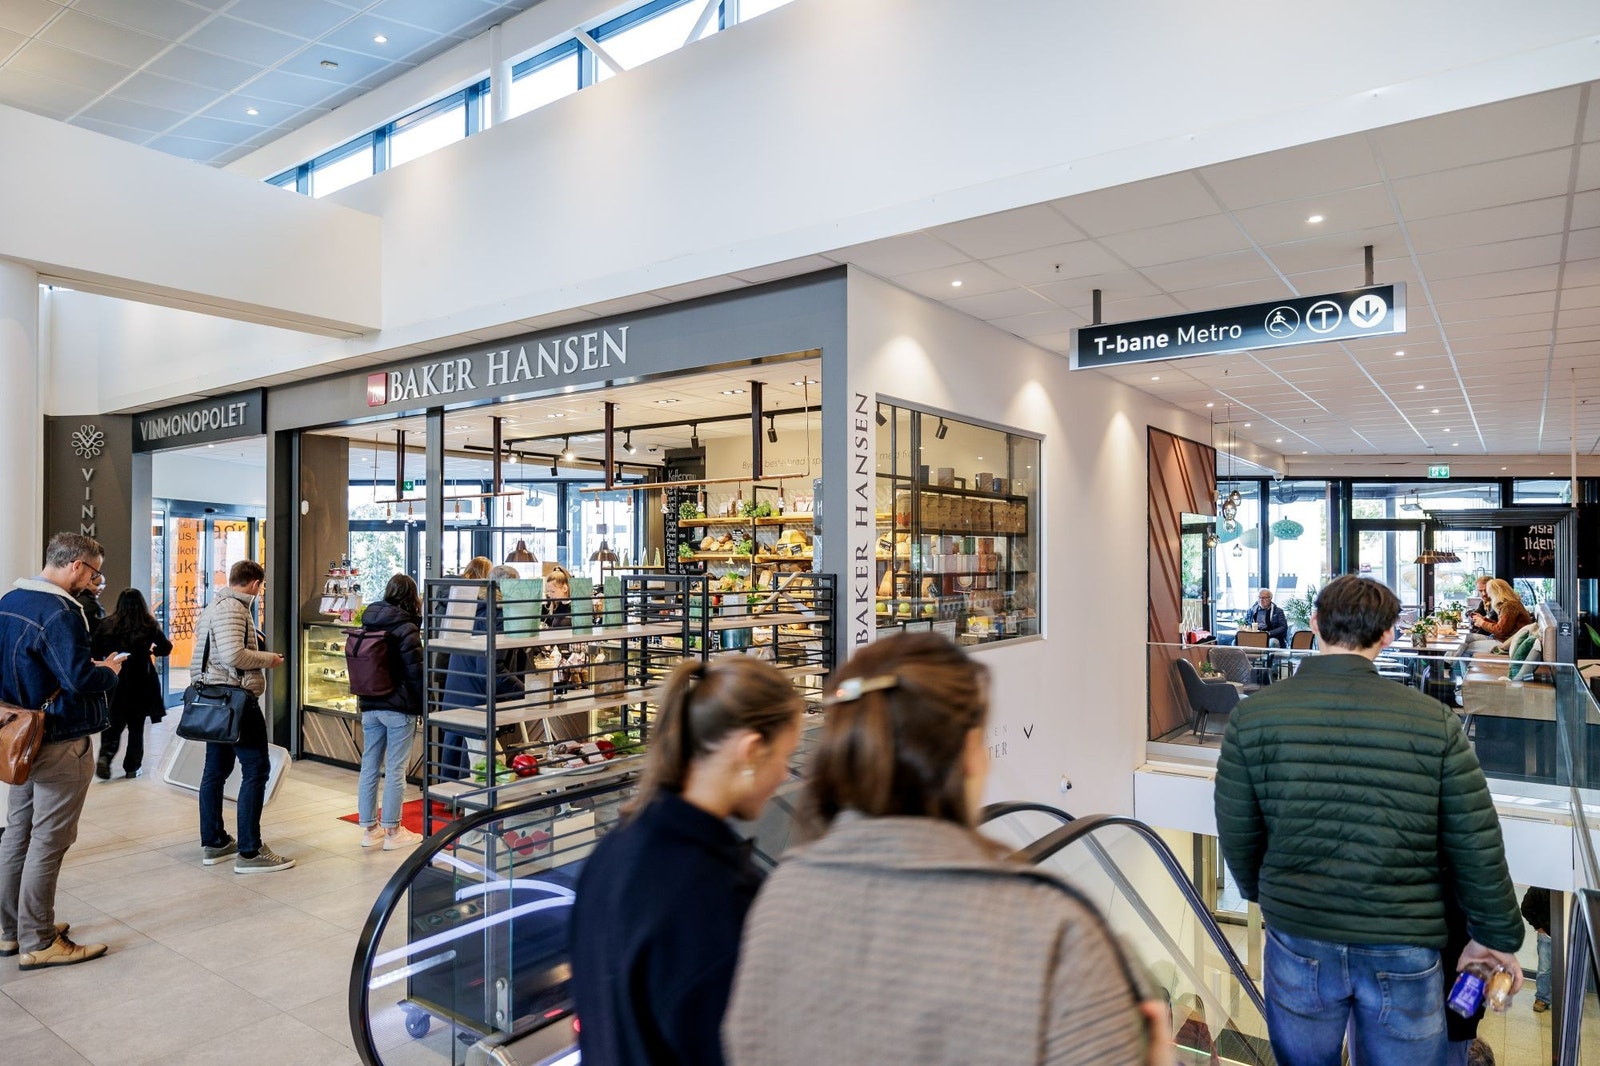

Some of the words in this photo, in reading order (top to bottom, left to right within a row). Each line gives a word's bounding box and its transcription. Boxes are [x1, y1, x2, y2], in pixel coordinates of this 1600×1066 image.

[390, 357, 477, 403] BAKER
[486, 326, 630, 386] HANSEN
[1094, 330, 1169, 356] T-bane
[1177, 323, 1242, 346] Metro
[140, 402, 248, 441] VINMONOPOLET
[855, 392, 869, 528] HANSEN
[855, 541, 869, 648] BAKER
